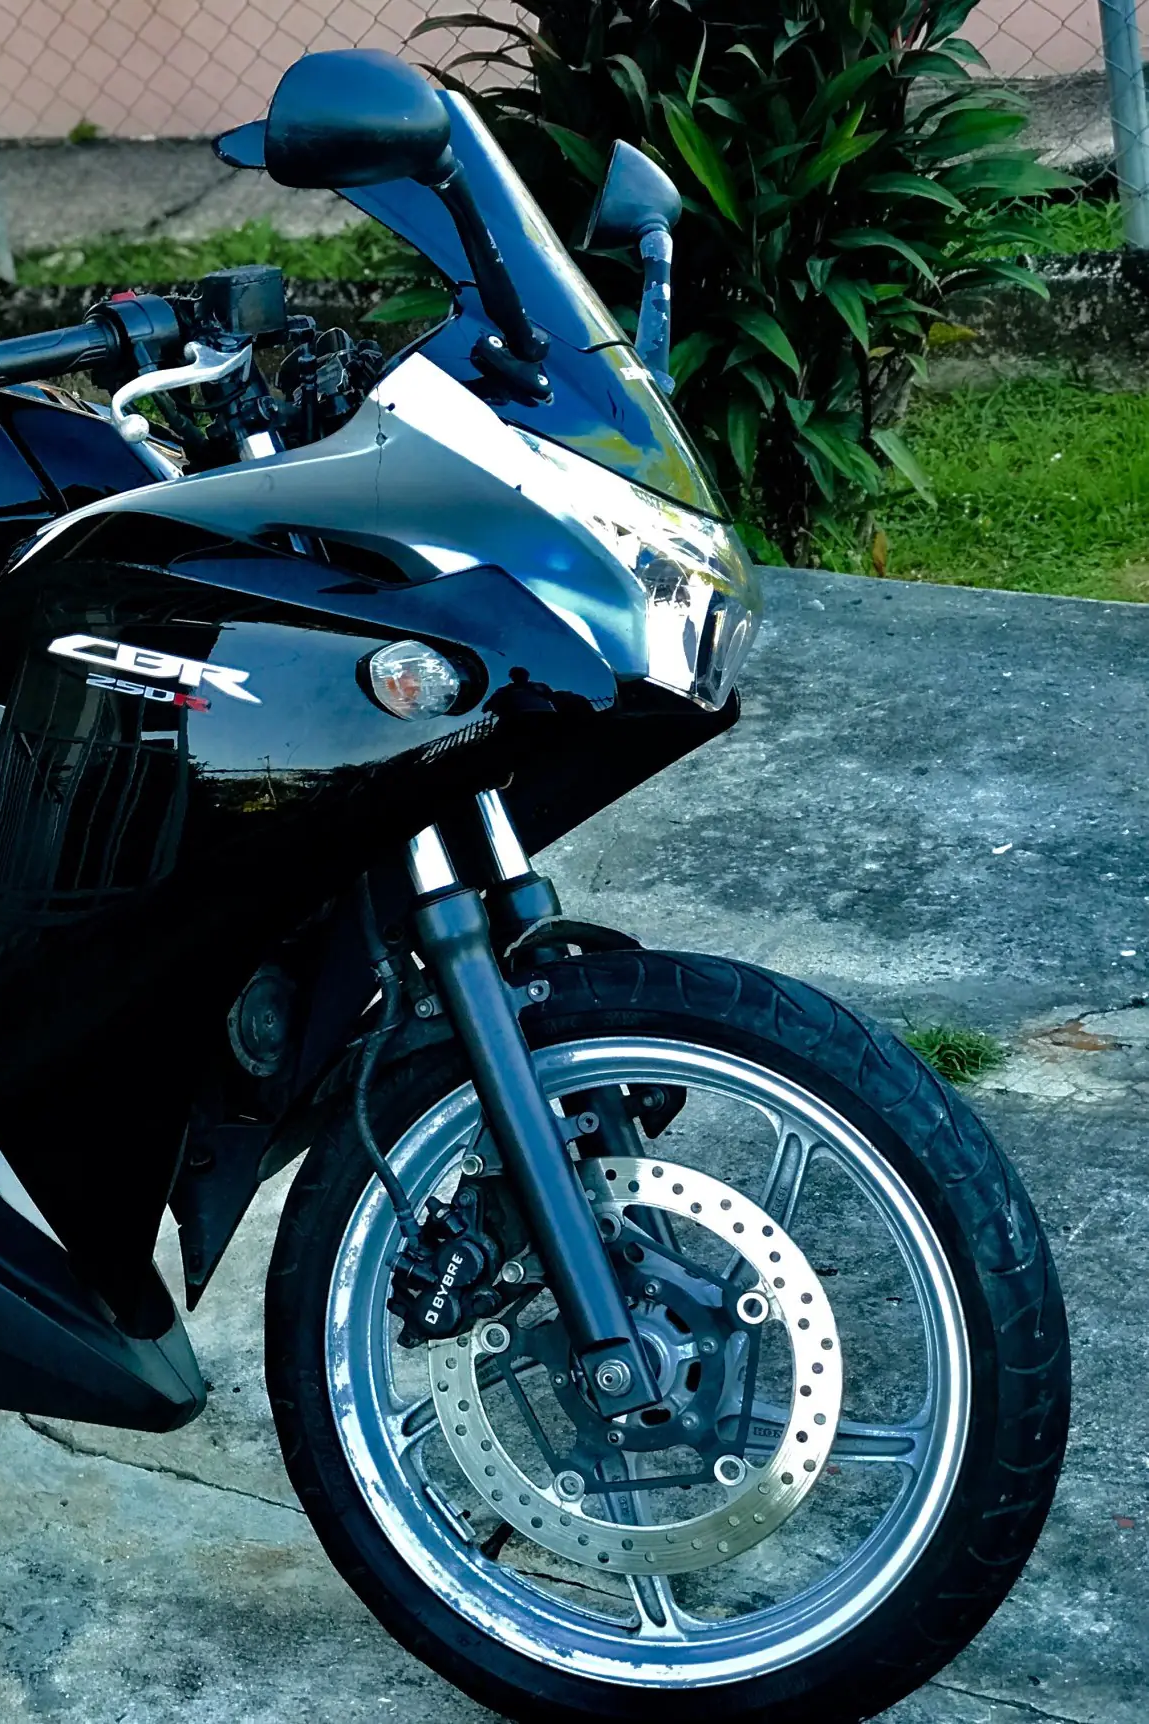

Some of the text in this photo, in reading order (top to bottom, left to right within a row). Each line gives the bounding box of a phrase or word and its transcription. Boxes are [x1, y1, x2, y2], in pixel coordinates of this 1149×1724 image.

[47, 633, 263, 706] CBR
[85, 672, 212, 713] 250R
[432, 1251, 464, 1309] BYBRE
[753, 1426, 784, 1439] HON
